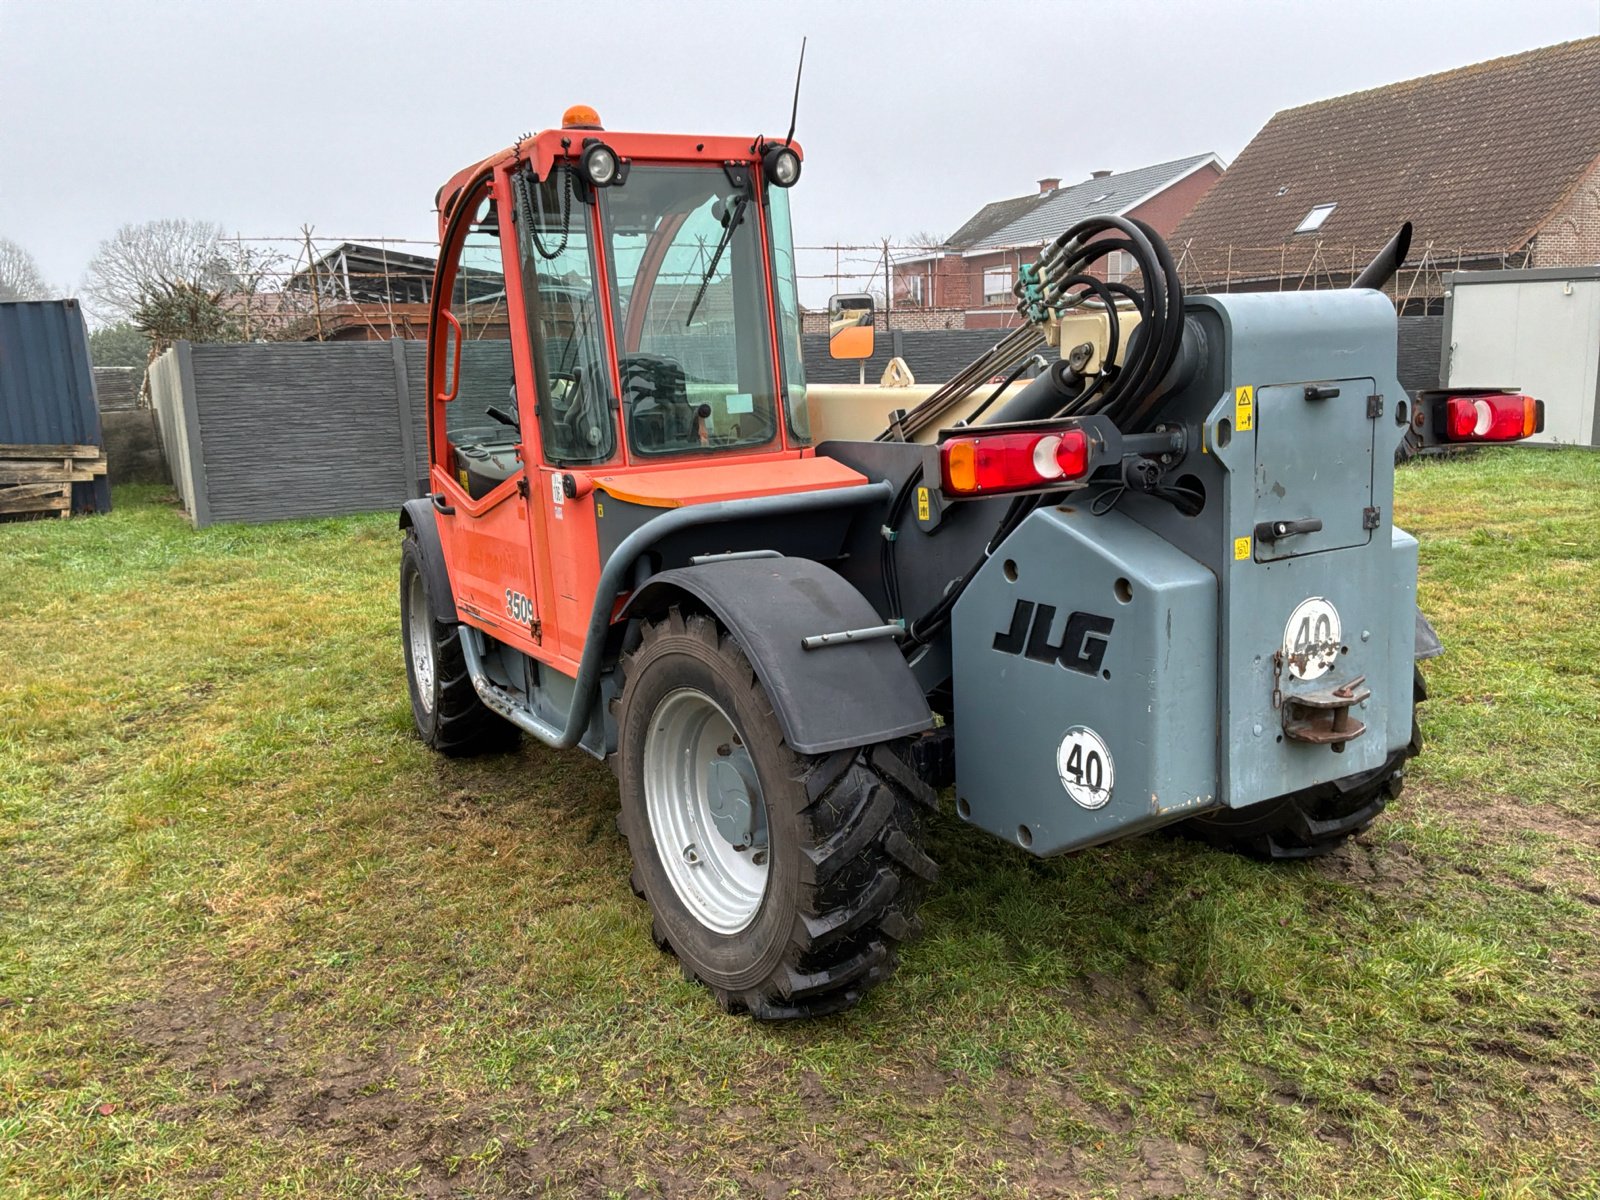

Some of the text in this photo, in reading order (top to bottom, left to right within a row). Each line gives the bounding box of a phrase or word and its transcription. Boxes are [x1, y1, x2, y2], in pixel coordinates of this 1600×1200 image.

[506, 588, 535, 626] 3509
[992, 599, 1115, 678] JLG
[1294, 613, 1331, 656] 40
[1066, 743, 1103, 790] 40
